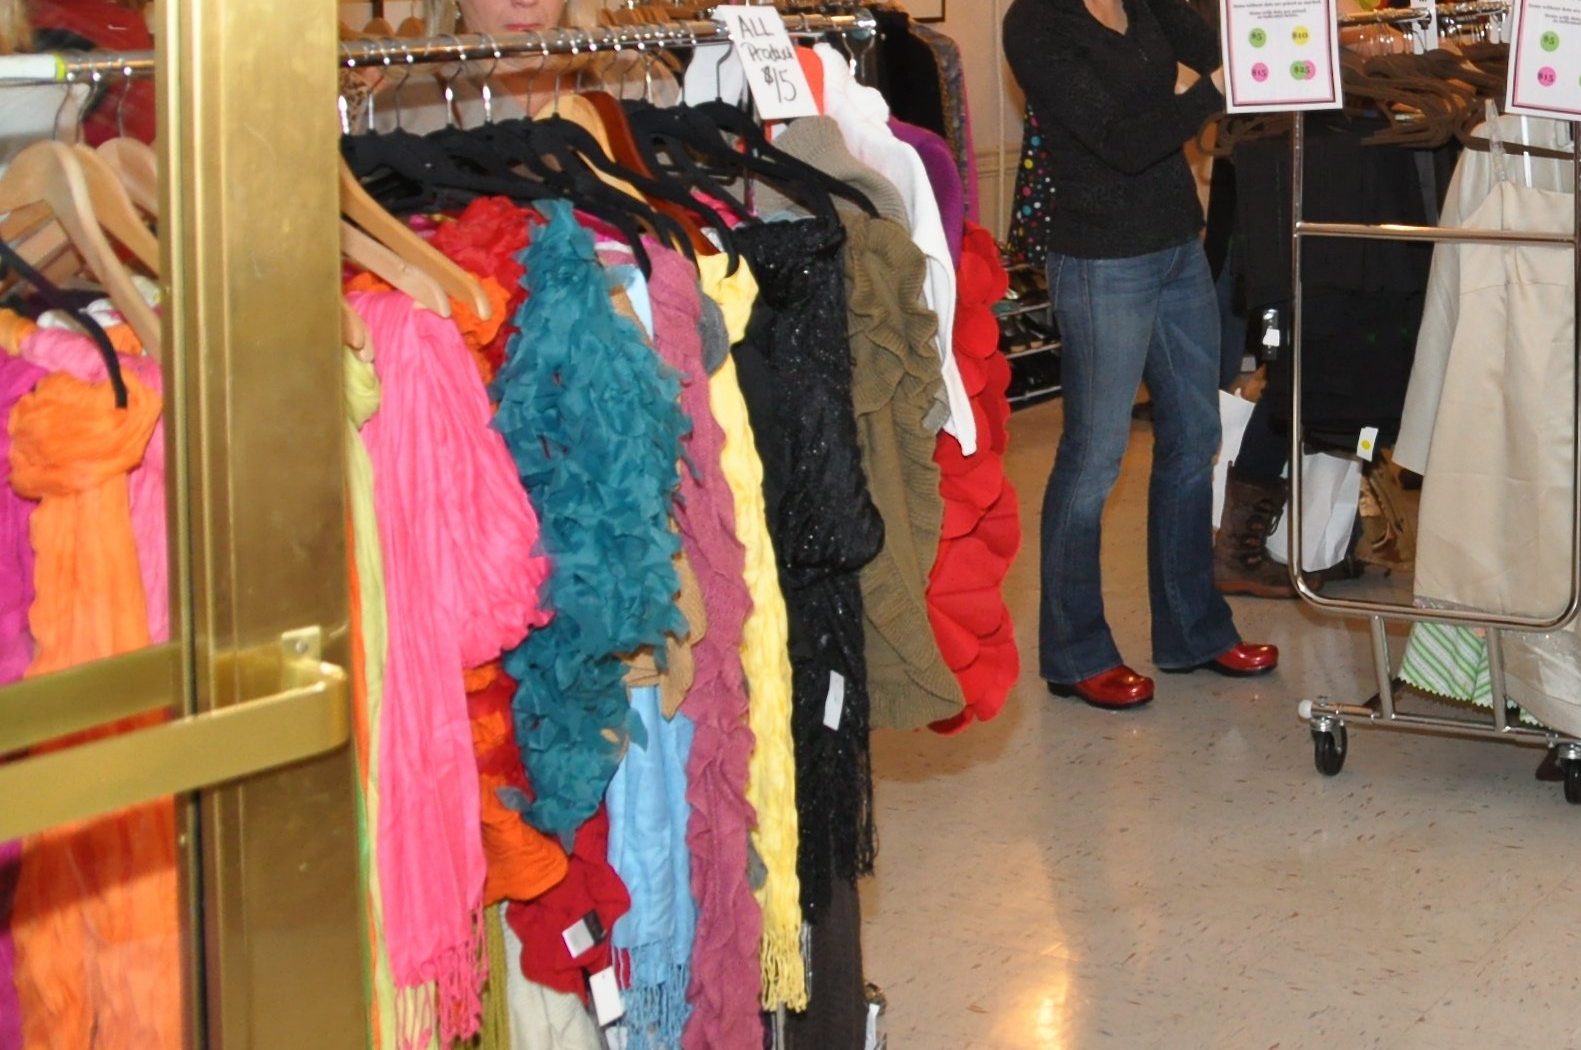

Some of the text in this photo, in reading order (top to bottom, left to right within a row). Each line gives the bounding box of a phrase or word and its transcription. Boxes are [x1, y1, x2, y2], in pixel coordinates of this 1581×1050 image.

[737, 15, 774, 39] ALL
[1251, 31, 1309, 41] $5 $10
[1542, 35, 1555, 46] $5
[1251, 65, 1311, 78] $15 $25
[1537, 71, 1554, 82] $15
[760, 64, 798, 104] $15
